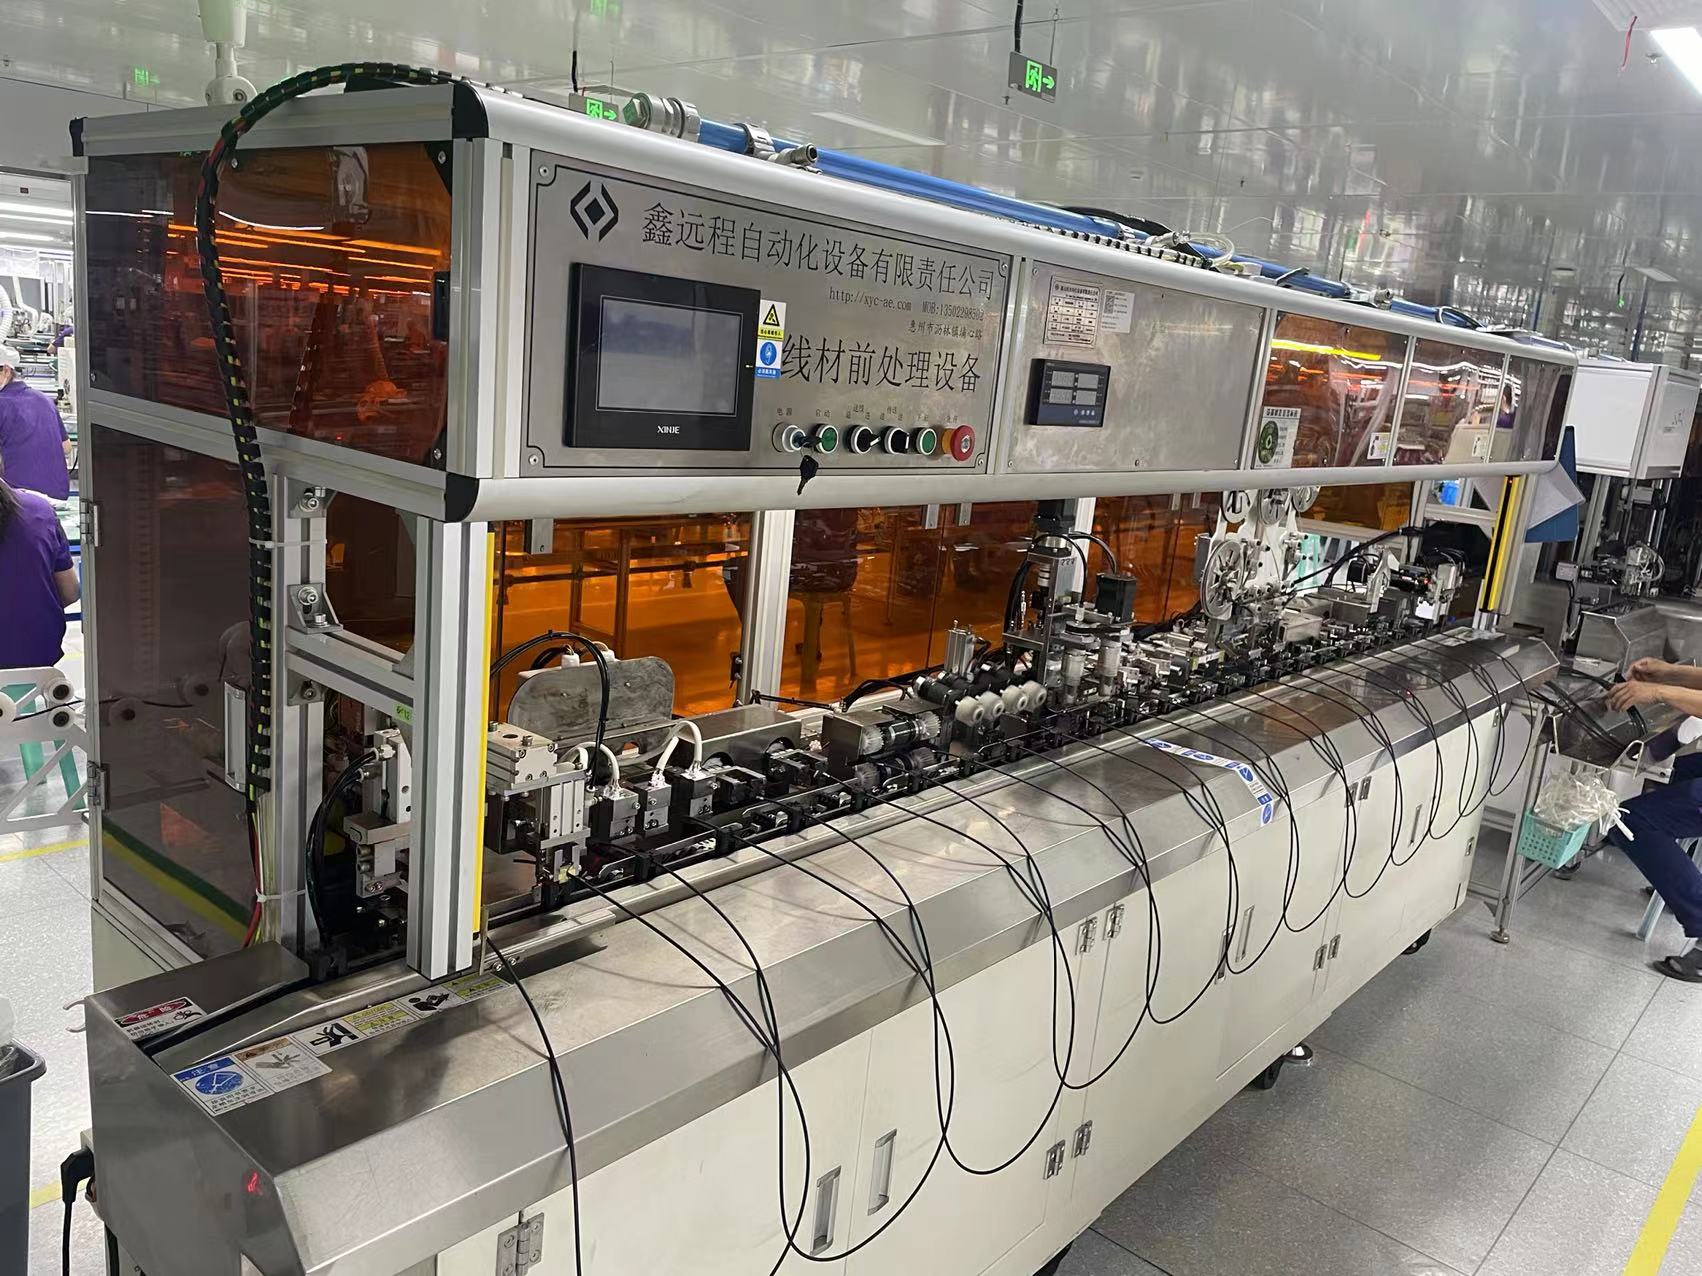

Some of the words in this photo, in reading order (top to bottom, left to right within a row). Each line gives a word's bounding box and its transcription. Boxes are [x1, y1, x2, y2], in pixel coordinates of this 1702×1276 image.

[642, 201, 995, 300] 鑫远程自动化设备有限责任公司
[829, 286, 912, 311] http://xyc-ae.com
[781, 333, 982, 393] 线材前处理设备
[657, 425, 680, 434] XINJE
